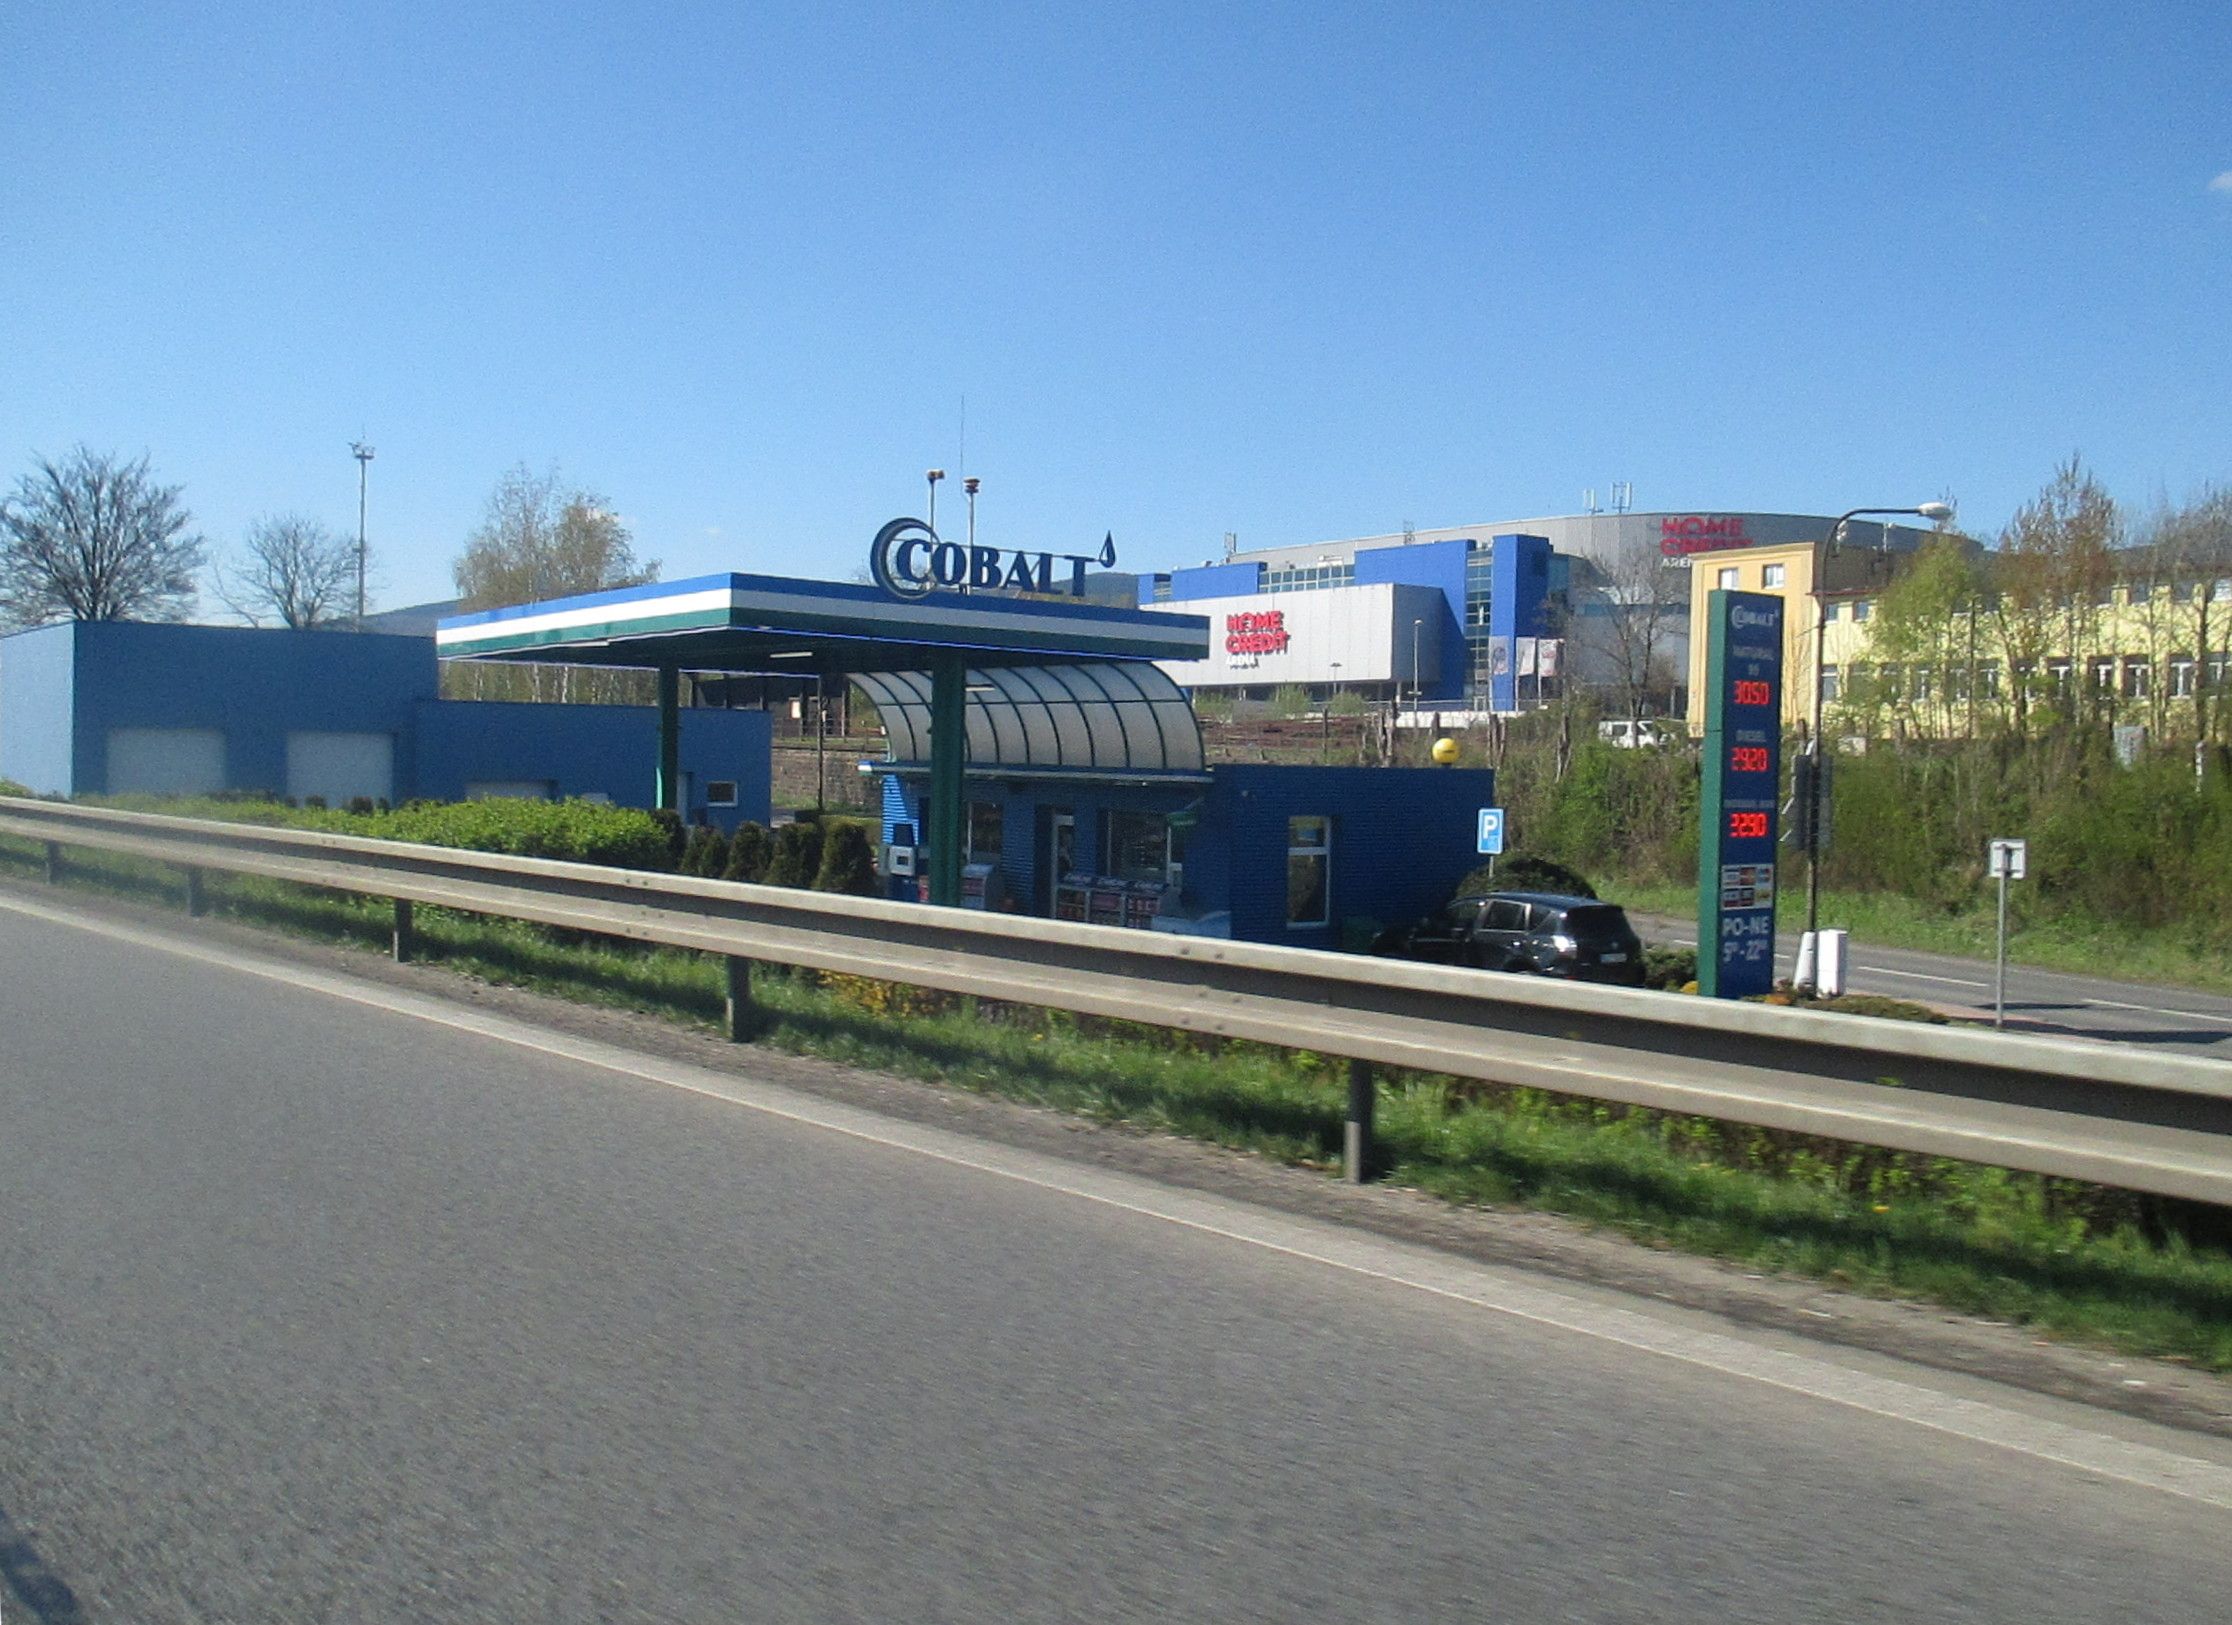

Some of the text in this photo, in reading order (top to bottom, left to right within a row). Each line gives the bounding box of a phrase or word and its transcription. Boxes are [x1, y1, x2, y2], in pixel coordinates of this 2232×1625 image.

[1661, 516, 1744, 536] HOME
[870, 517, 1095, 599] COBALT
[1226, 610, 1284, 633] HOME
[1225, 630, 1289, 654] CREDIT
[1483, 815, 1498, 839] P
